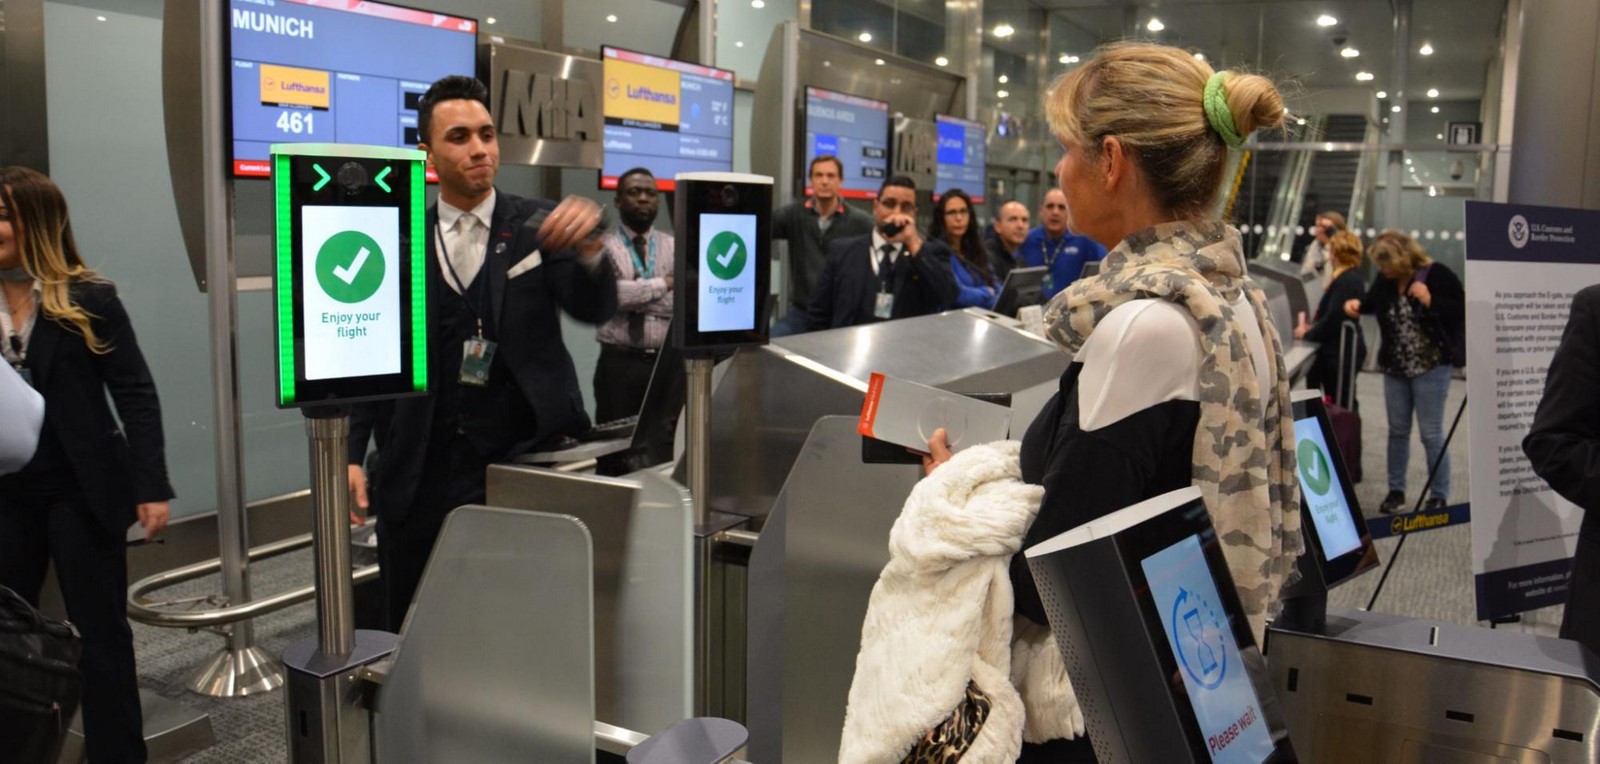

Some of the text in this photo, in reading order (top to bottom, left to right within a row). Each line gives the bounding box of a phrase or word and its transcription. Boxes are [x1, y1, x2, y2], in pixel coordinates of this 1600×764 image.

[233, 9, 313, 39] MUNICH
[281, 81, 325, 94] Lufthansa
[627, 84, 676, 105] Lufthansa
[501, 69, 599, 140] MIA
[276, 111, 314, 134] 461
[1563, 225, 1573, 234] and
[708, 285, 743, 295] Enjoy your
[717, 295, 736, 305] flight
[321, 311, 381, 326] Enjoy your
[337, 326, 367, 339] flight
[1403, 512, 1449, 531] Lufthansa
[1208, 707, 1257, 756] Please wait
